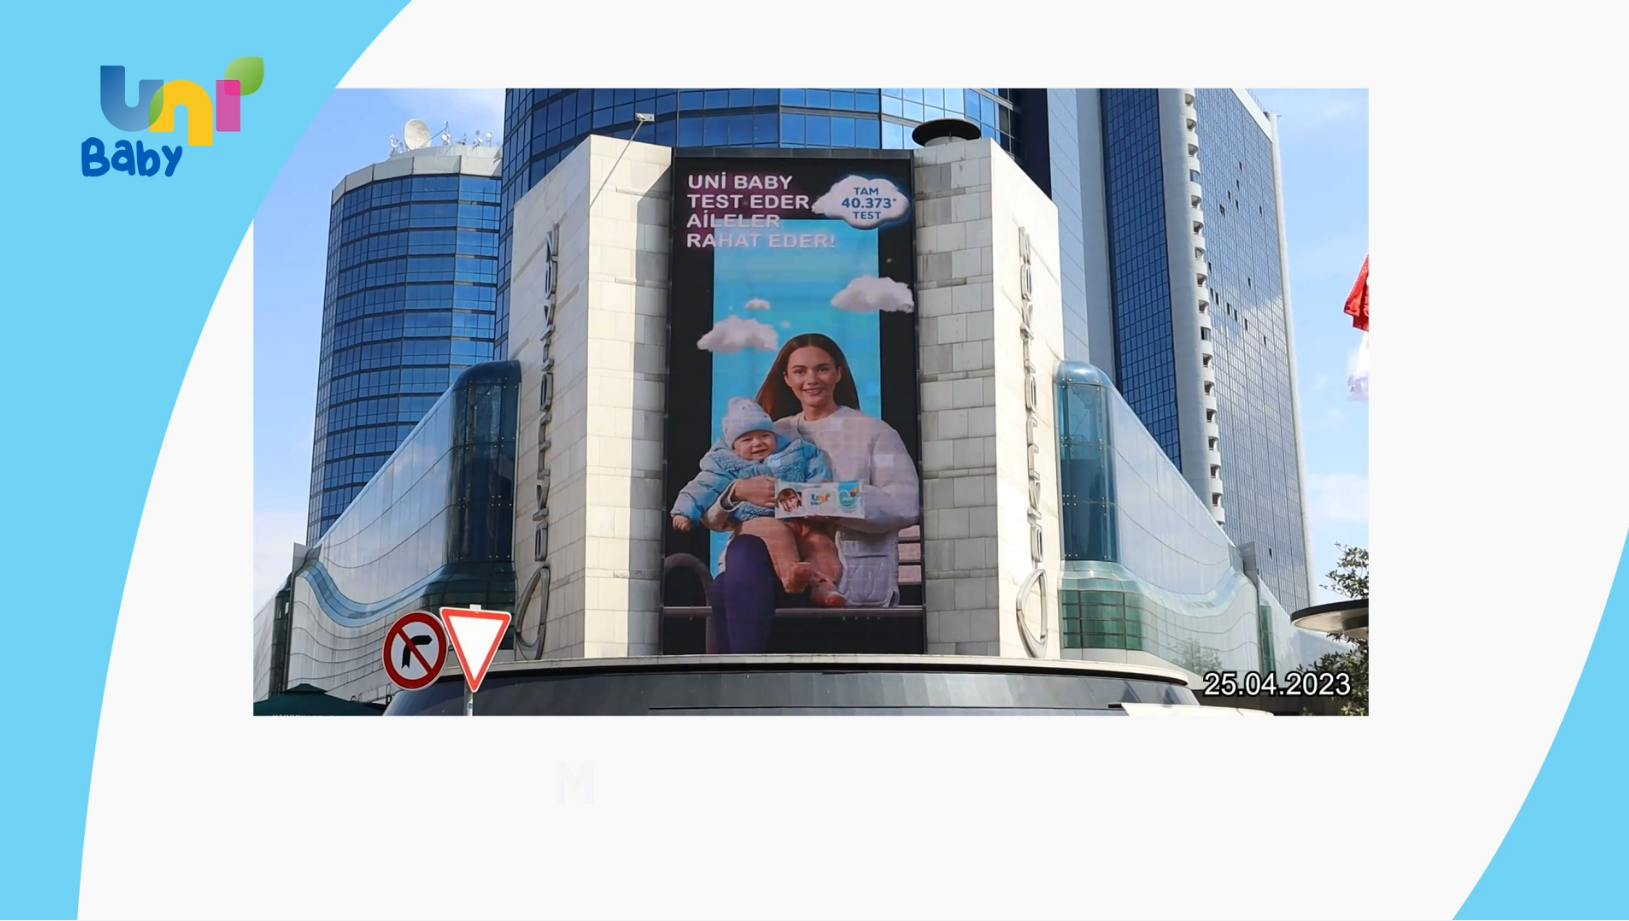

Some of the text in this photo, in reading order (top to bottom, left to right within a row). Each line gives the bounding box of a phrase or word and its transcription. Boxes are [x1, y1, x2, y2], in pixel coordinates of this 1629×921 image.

[688, 171, 793, 190] UNİ BABY
[853, 187, 879, 196] TAM
[687, 194, 747, 209] TEST
[686, 211, 781, 229] AİLELER
[852, 211, 882, 220] TEST
[686, 233, 835, 249] RAHAT EDER!
